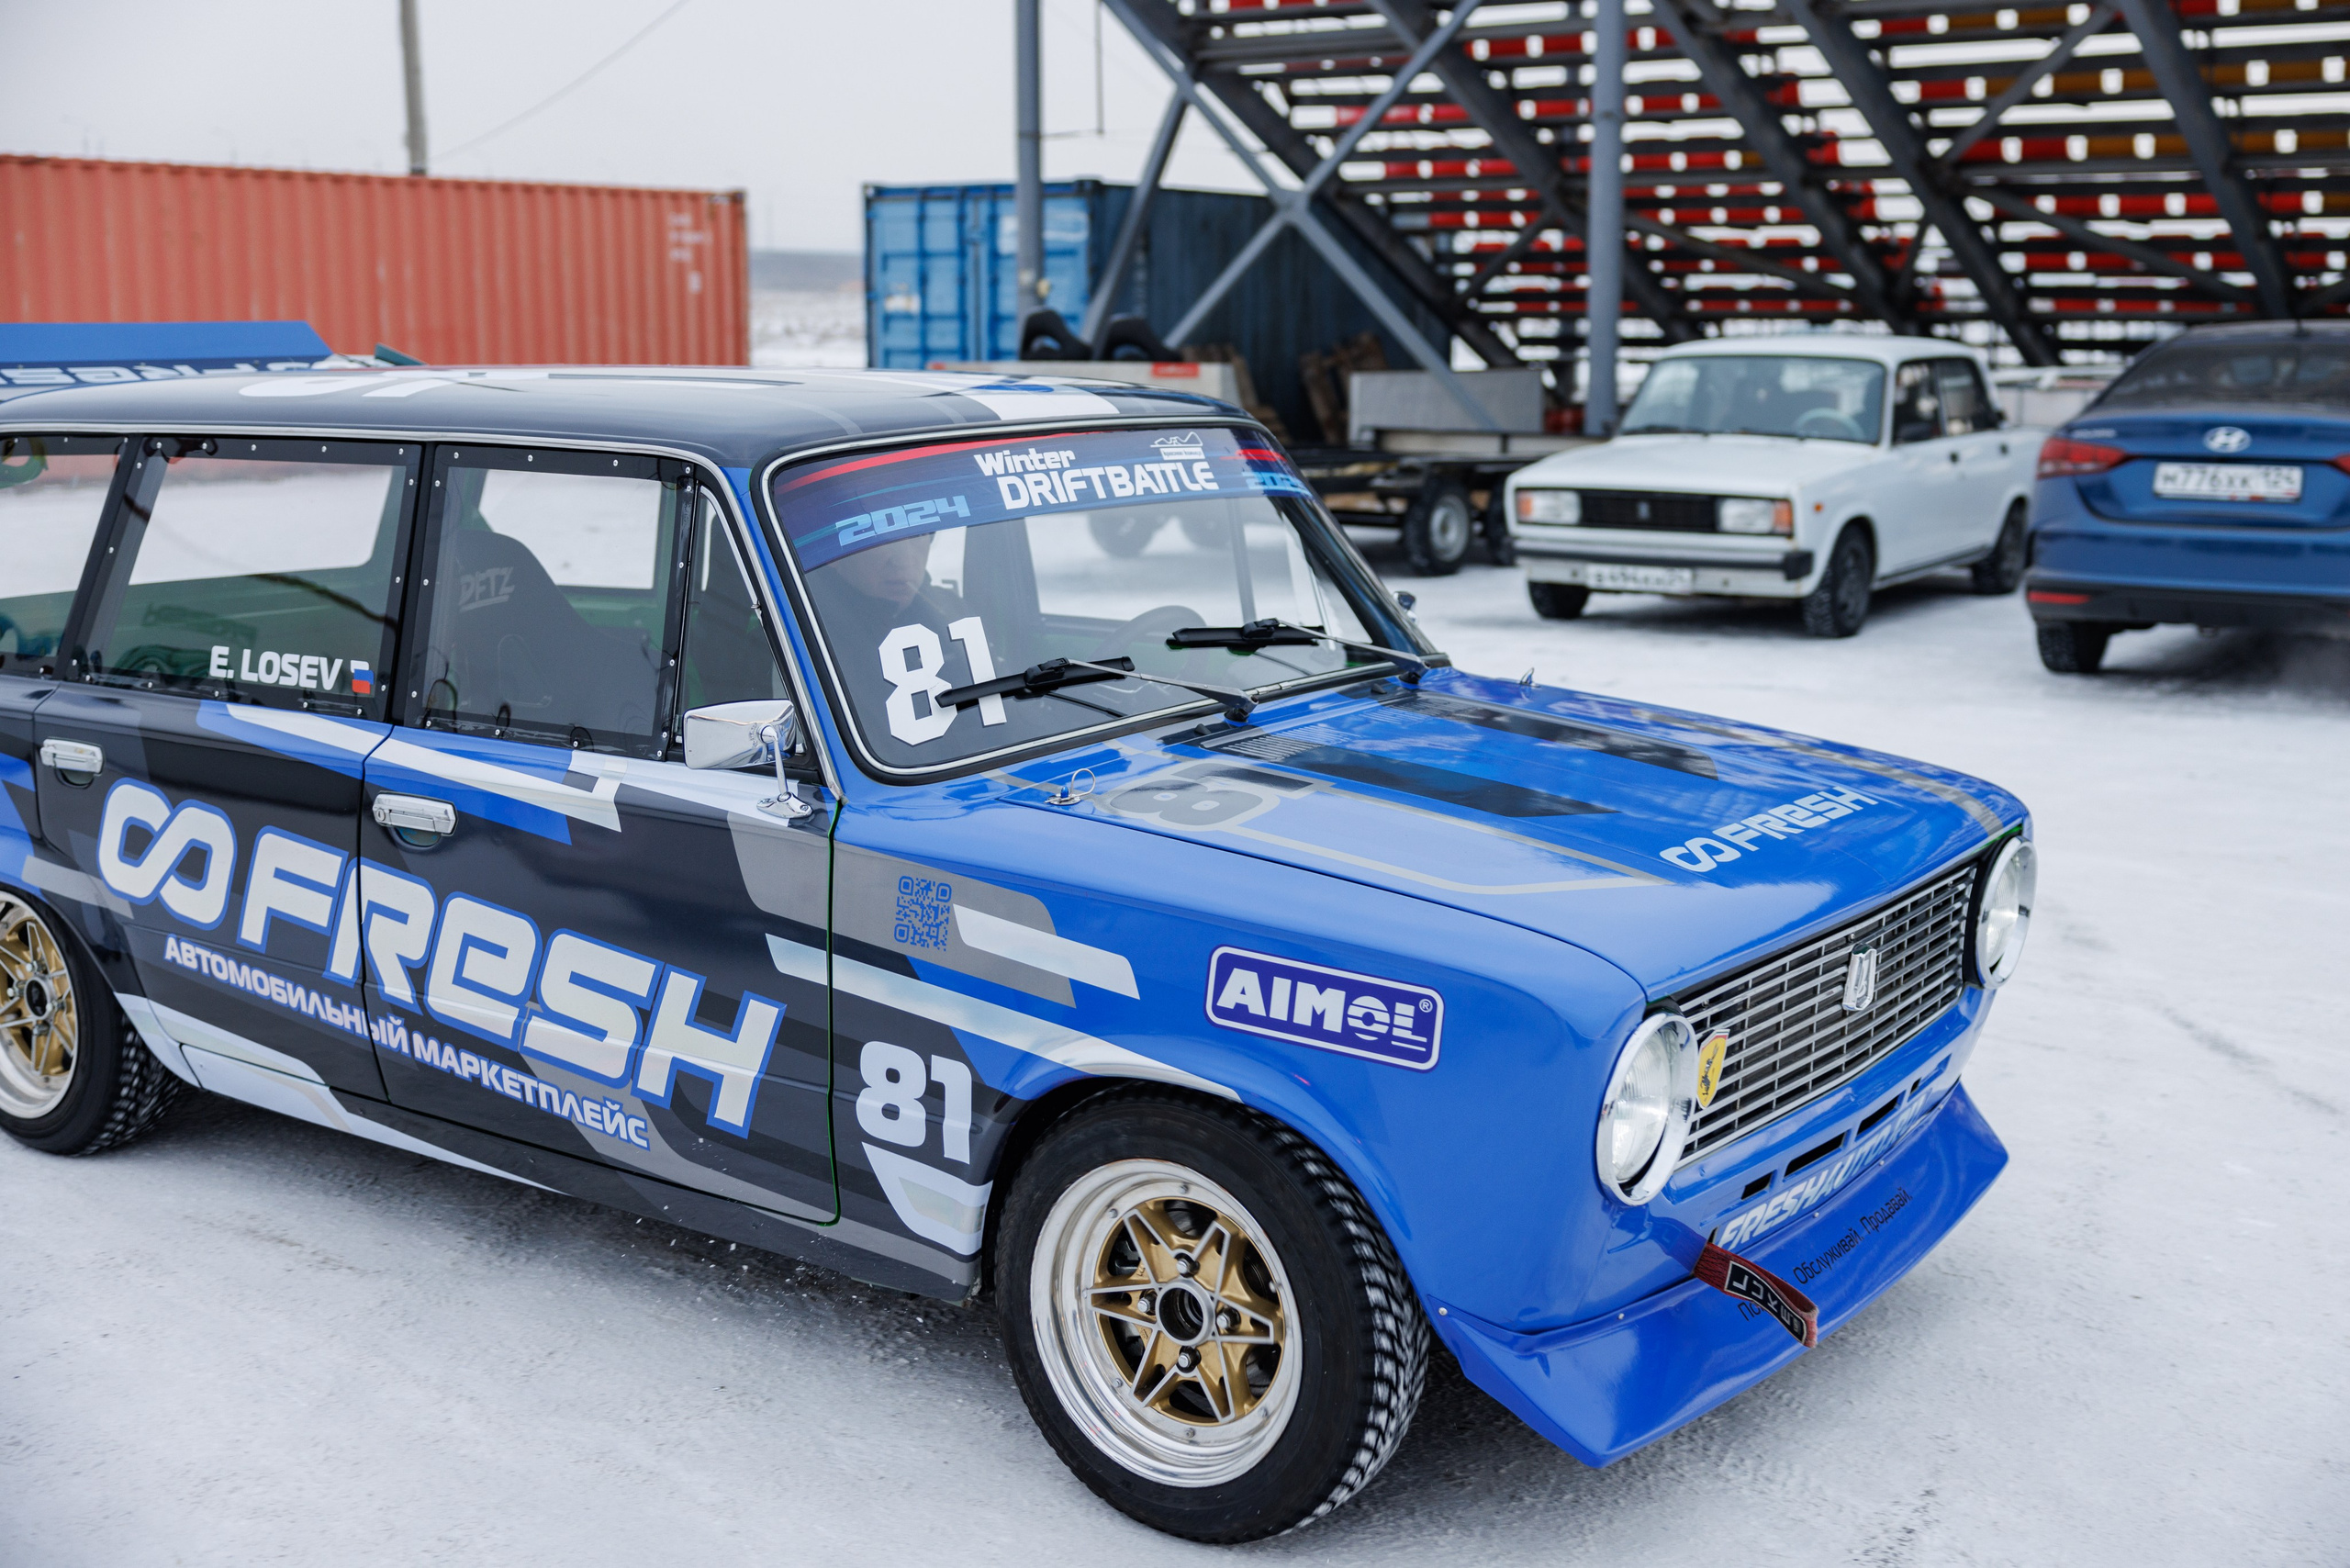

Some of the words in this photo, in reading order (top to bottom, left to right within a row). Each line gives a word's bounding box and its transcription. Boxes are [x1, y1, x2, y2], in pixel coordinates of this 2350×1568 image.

[973, 448, 1076, 476] Winter
[837, 496, 971, 546] 2024
[209, 645, 235, 679] E.
[241, 648, 343, 690] LOSEV
[878, 616, 1007, 746] 81
[162, 933, 410, 1062] АВТОМОБИЛЬНЫЙ
[411, 1028, 652, 1151] МАРКЕТПЛЕЙС
[856, 1040, 972, 1165] 81
